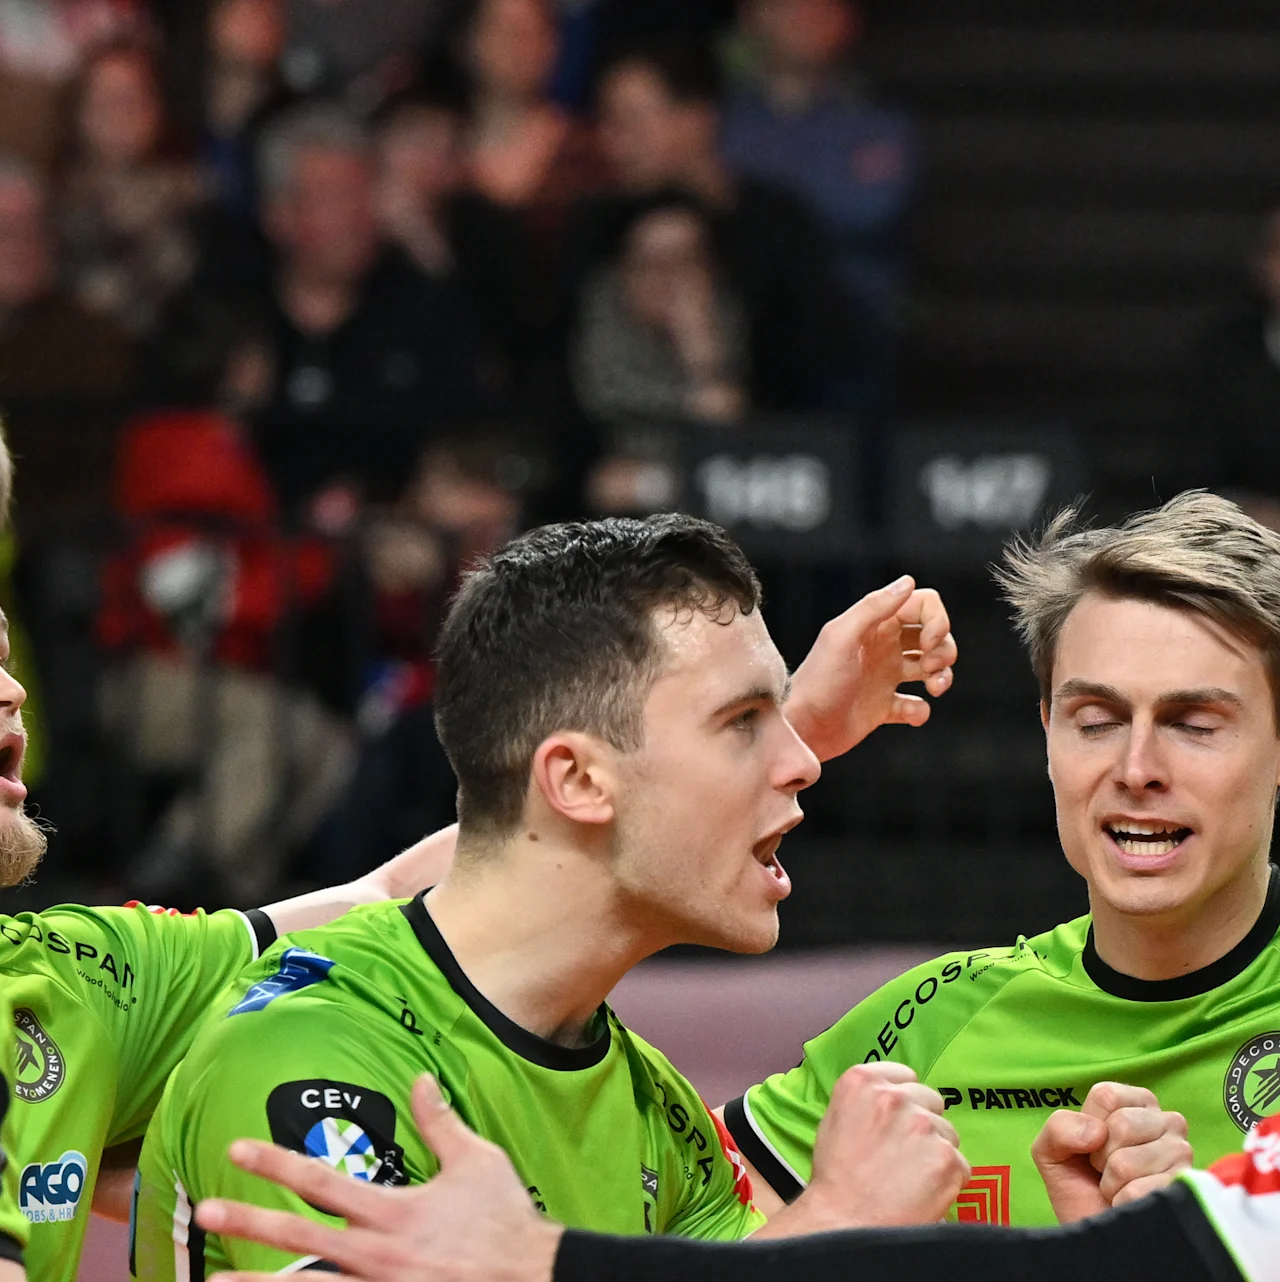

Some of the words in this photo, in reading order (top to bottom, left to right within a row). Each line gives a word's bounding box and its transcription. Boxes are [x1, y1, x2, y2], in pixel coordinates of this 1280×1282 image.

[300, 1088, 362, 1110] CEV
[967, 1087, 1082, 1110] PATRICK
[1228, 1094, 1258, 1131] VOLLE
[21, 1162, 84, 1207] AGO
